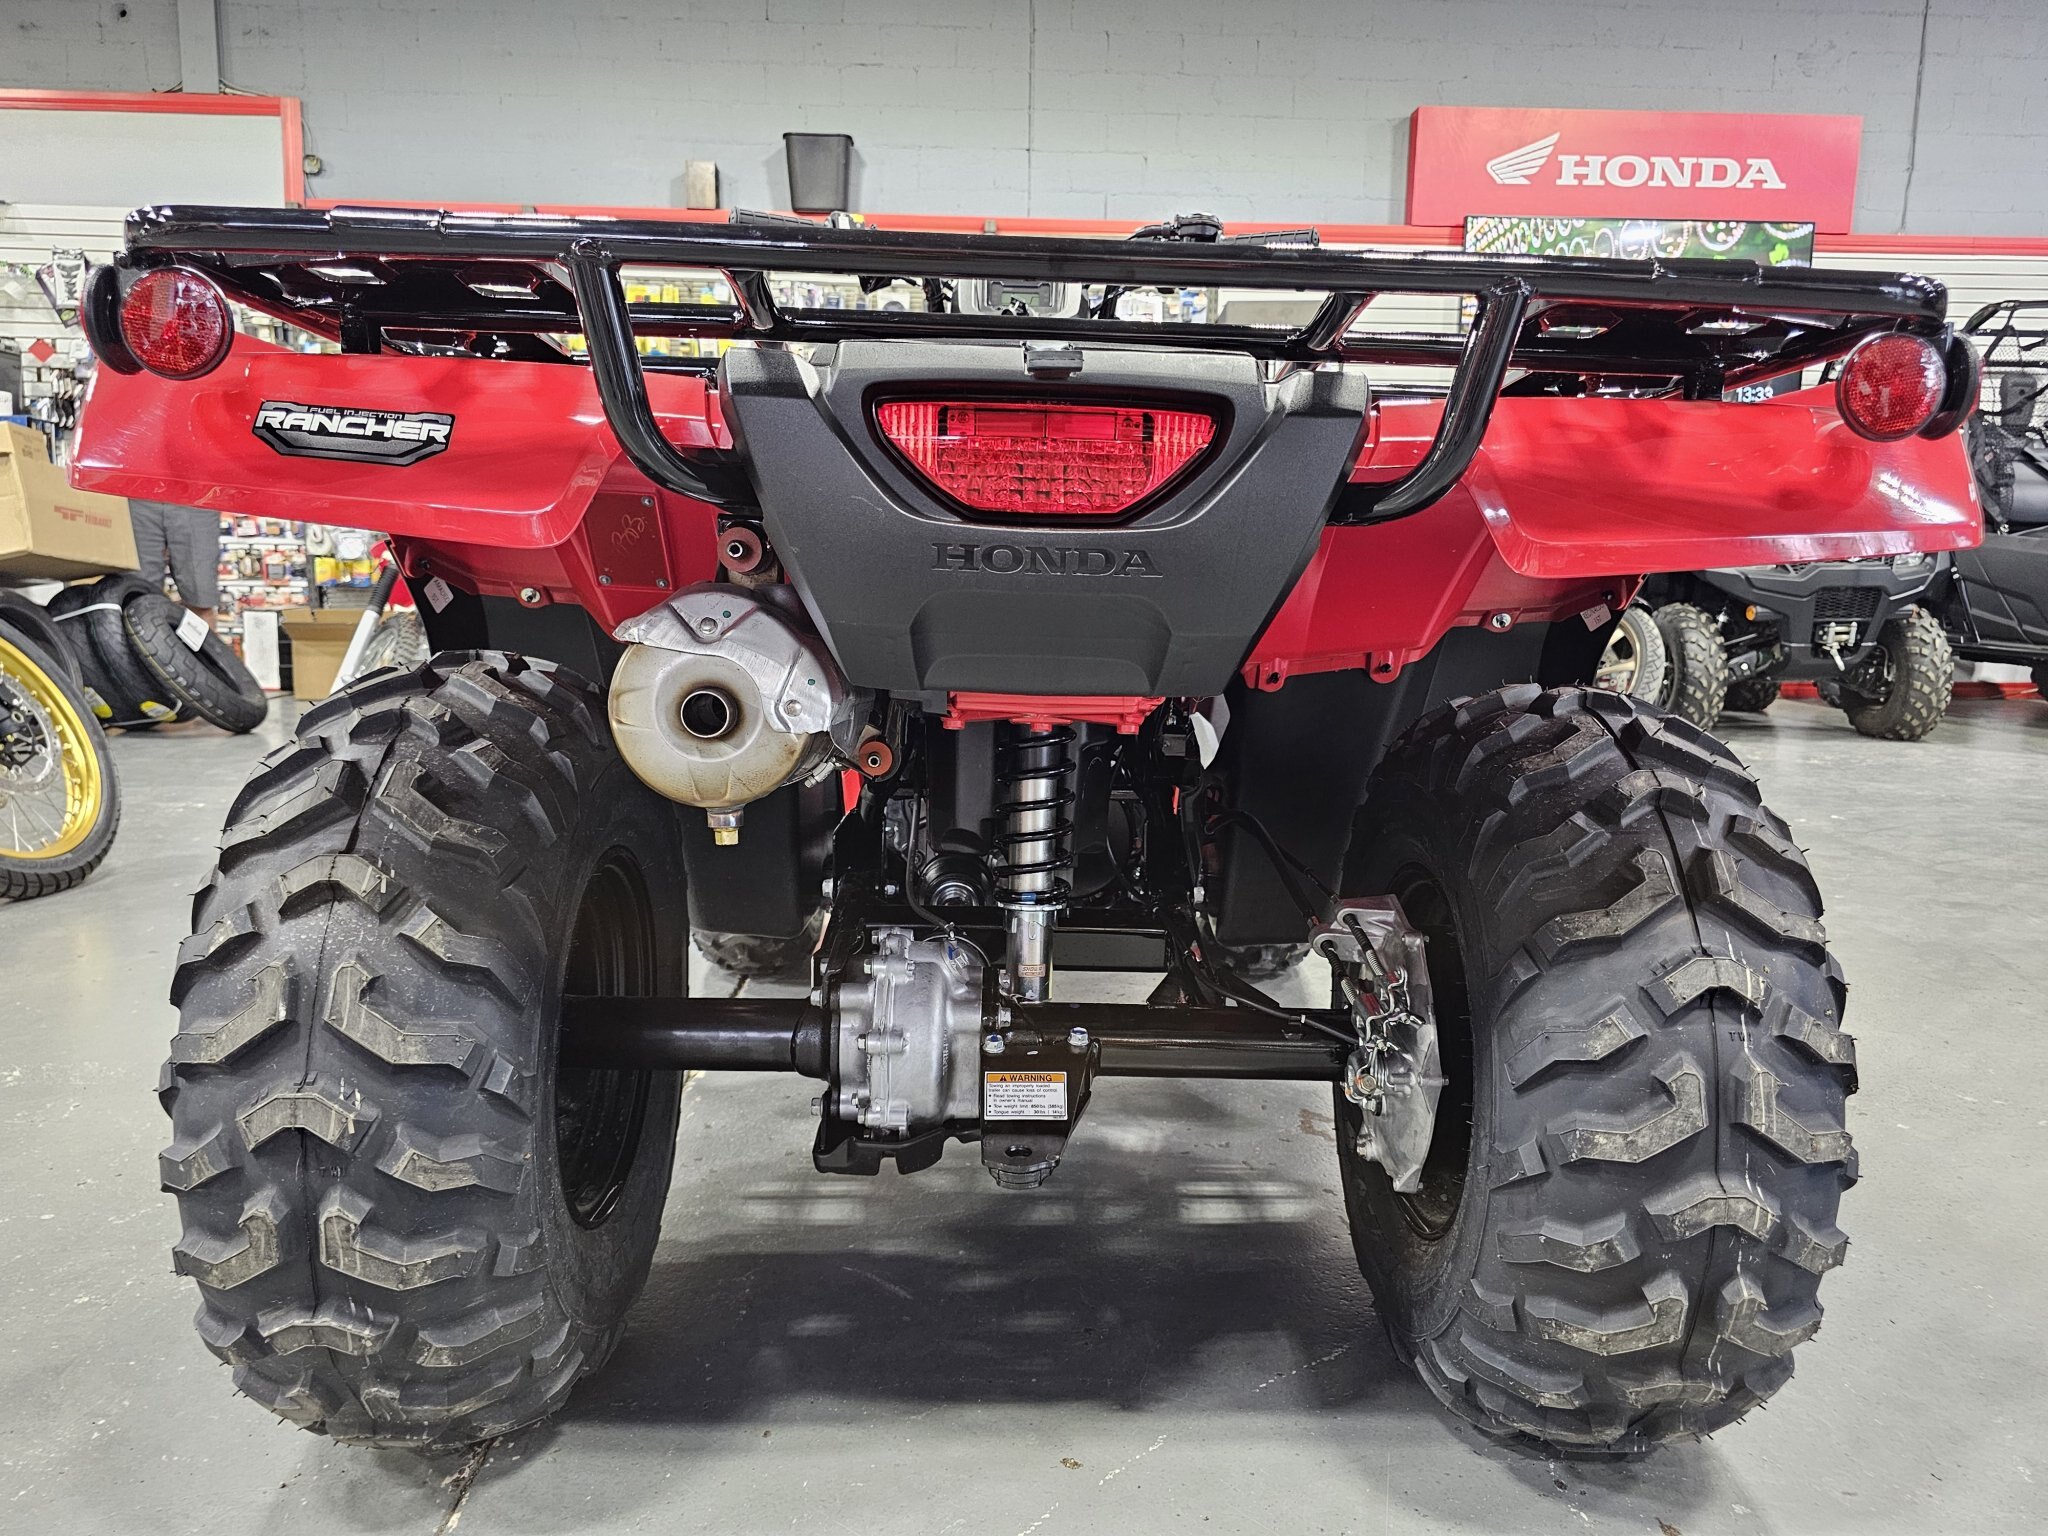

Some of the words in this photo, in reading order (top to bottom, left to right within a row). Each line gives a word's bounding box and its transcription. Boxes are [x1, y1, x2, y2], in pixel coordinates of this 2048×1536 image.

[1555, 154, 1787, 190] HONDA
[255, 410, 451, 443] RANCHER
[309, 407, 342, 416] FUEL
[343, 409, 403, 419] INJECTION
[931, 542, 1164, 578] HONDA
[1009, 1074, 1052, 1082] WARNING
